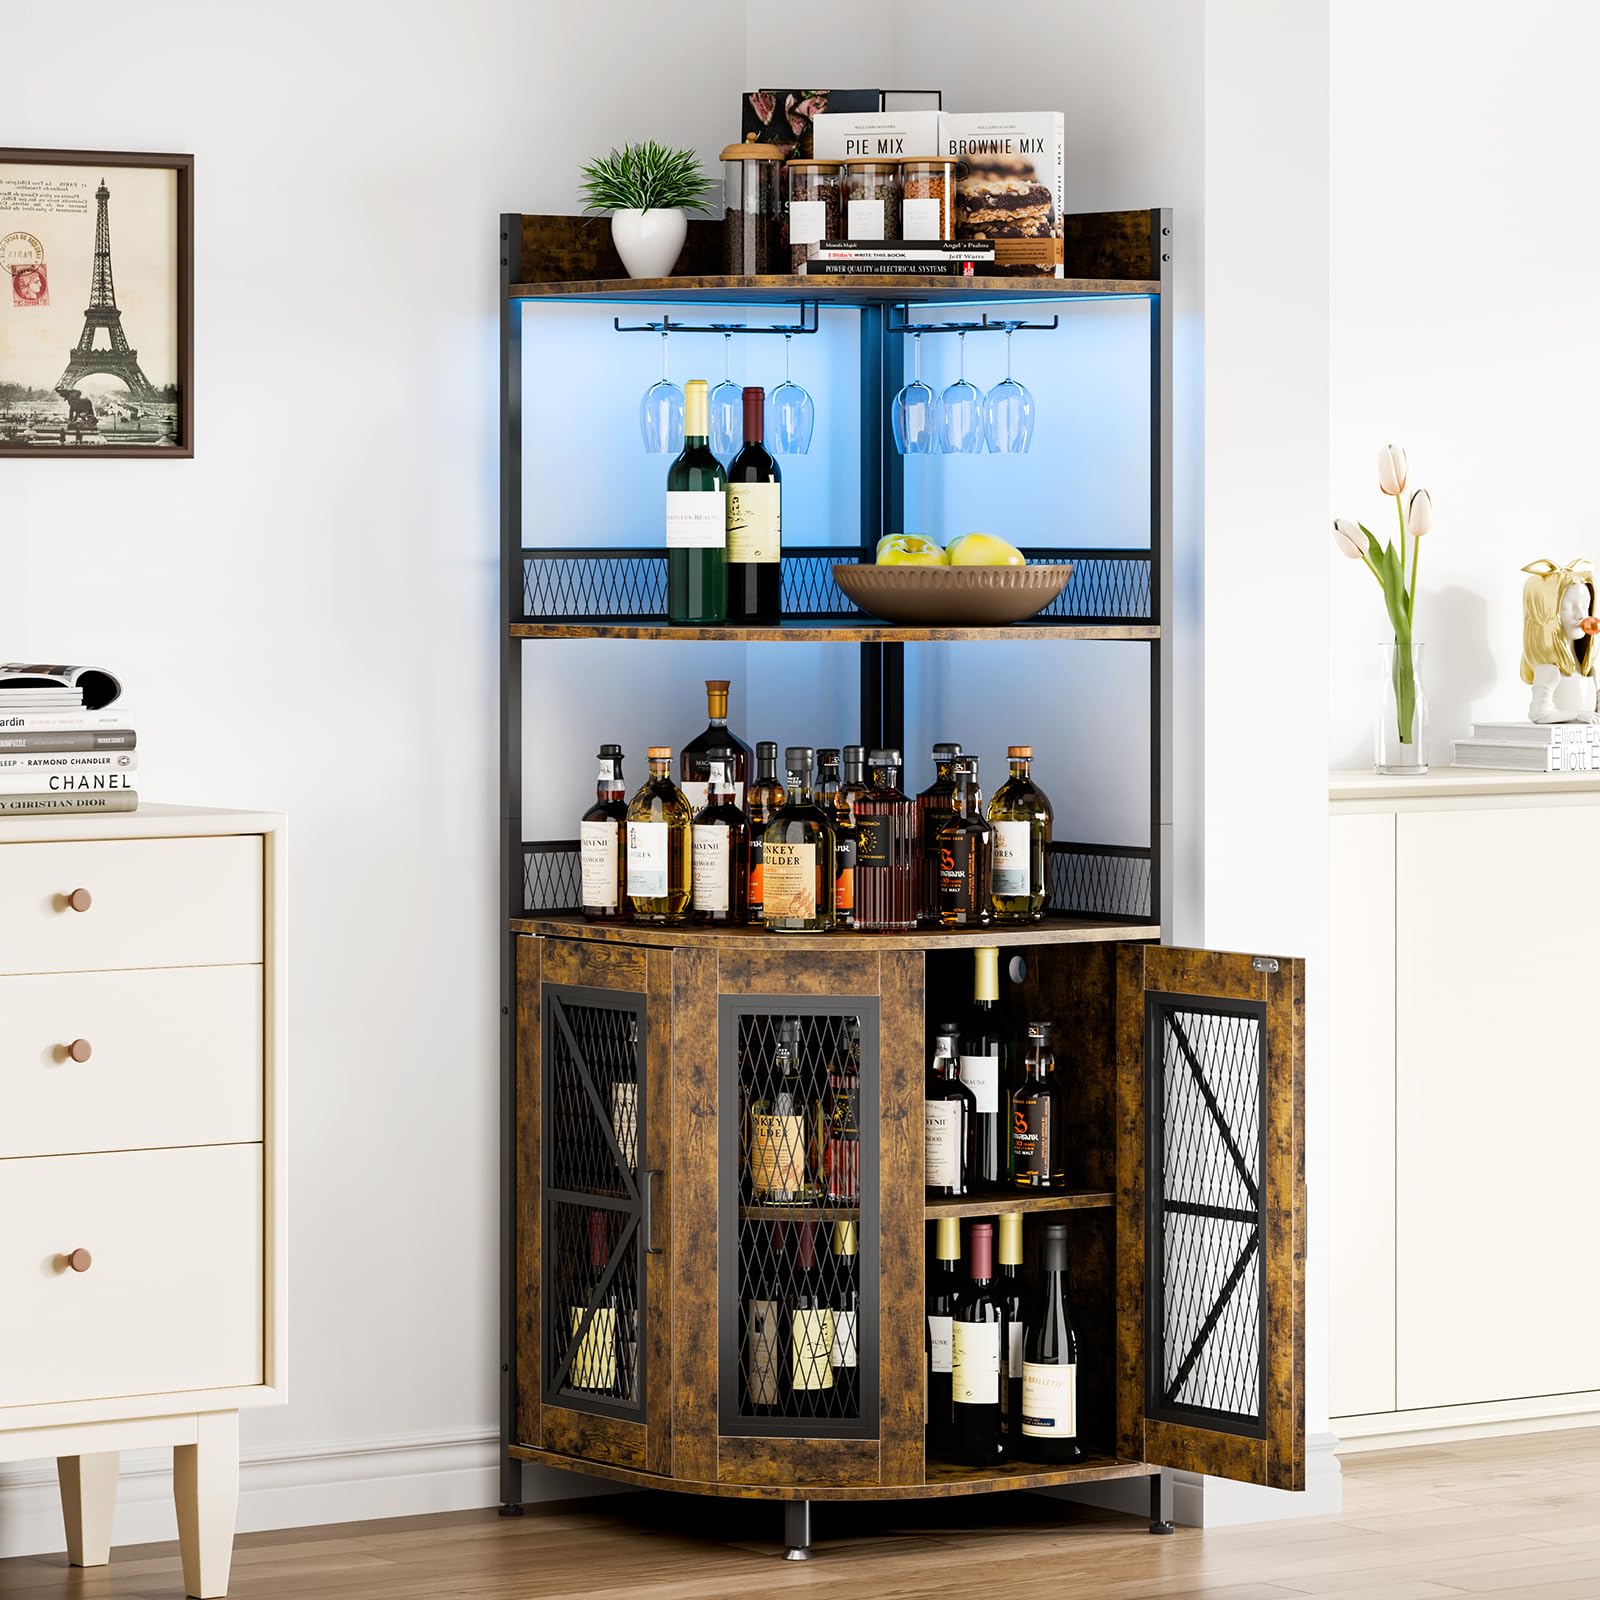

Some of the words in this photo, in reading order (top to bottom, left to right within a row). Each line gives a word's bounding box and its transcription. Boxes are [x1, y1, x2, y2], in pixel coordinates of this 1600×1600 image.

[846, 139, 870, 155] PIE
[877, 139, 904, 155] MIX
[949, 139, 1013, 156] BROWNIE
[1020, 138, 1045, 154] MIX
[826, 265, 846, 273] POWER
[847, 265, 873, 274] QUALITY
[880, 265, 917, 273] ELECTRICAL
[918, 265, 947, 273] SYSTEMS
[0, 717, 25, 727] ardin
[1552, 746, 1586, 771] Elliott
[1591, 746, 1600, 770] E
[49, 774, 131, 790] CHANEL
[10, 800, 73, 809] CHRISTIAN
[76, 799, 106, 807] DIOR
[941, 848, 955, 871] S
[1014, 1112, 1028, 1133] S
